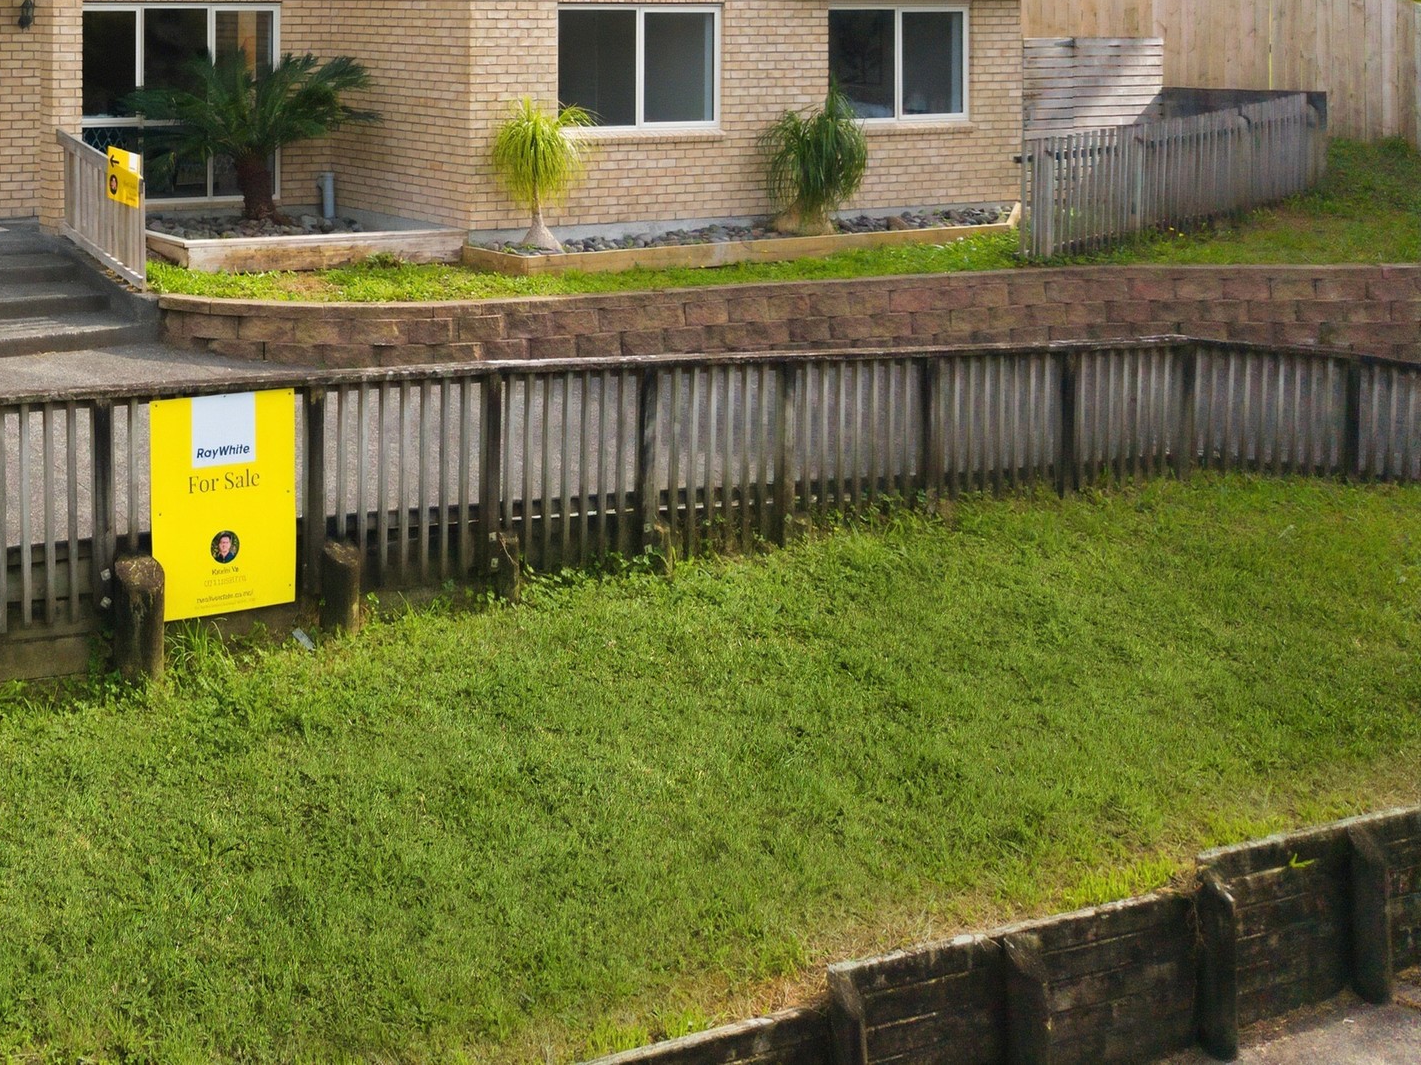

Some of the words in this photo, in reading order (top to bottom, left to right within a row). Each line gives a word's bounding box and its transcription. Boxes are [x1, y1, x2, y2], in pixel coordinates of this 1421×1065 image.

[196, 444, 250, 459] RayWhite
[188, 475, 220, 494] For
[224, 468, 260, 490] Sale
